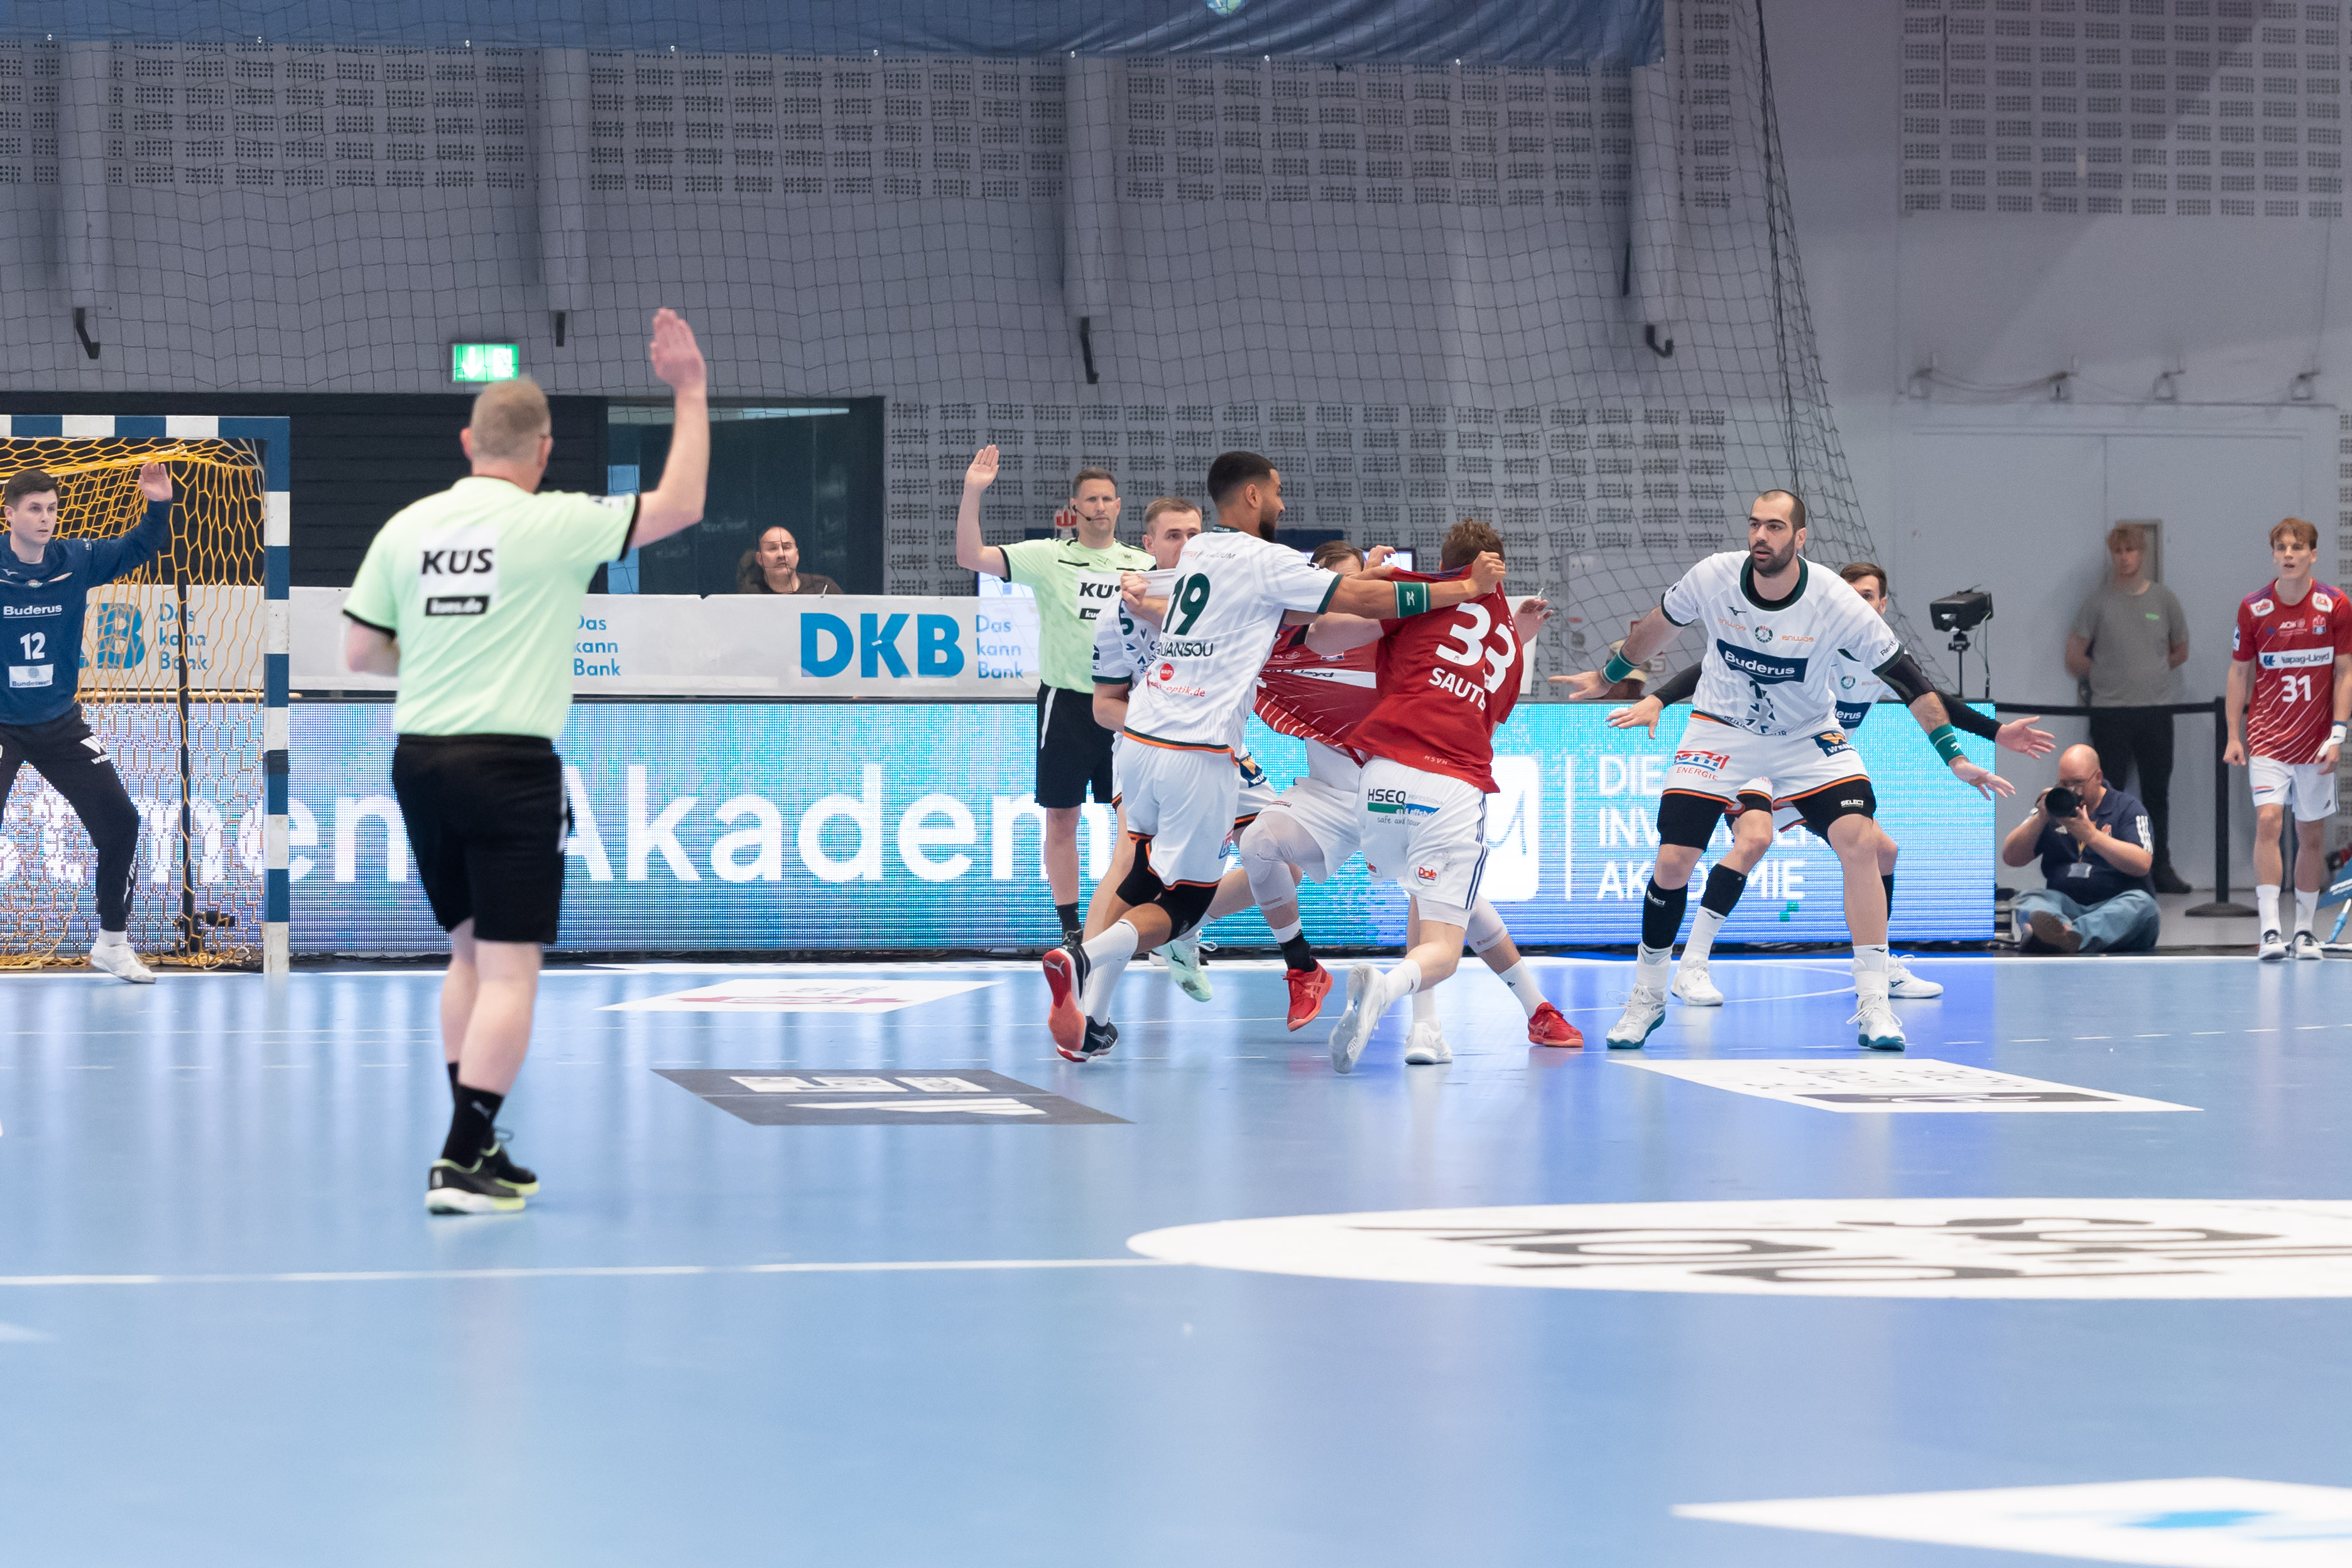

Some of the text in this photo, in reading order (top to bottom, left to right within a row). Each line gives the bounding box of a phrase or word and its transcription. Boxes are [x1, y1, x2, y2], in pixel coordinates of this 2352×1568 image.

[3, 604, 62, 616] Buderus
[1162, 573, 1211, 636] 19
[976, 614, 1011, 633] Das
[20, 632, 46, 660] 12
[800, 612, 964, 678] DKB
[976, 638, 1021, 656] kann
[1435, 602, 1516, 694] 33
[574, 658, 621, 676] Bank
[978, 661, 1023, 679] Bank
[1724, 650, 1795, 675] Buderus
[2281, 675, 2312, 702] 31
[1676, 766, 1718, 781] ENERGIE
[1368, 788, 1407, 806] HSEQ
[1418, 866, 1438, 879] Dole
